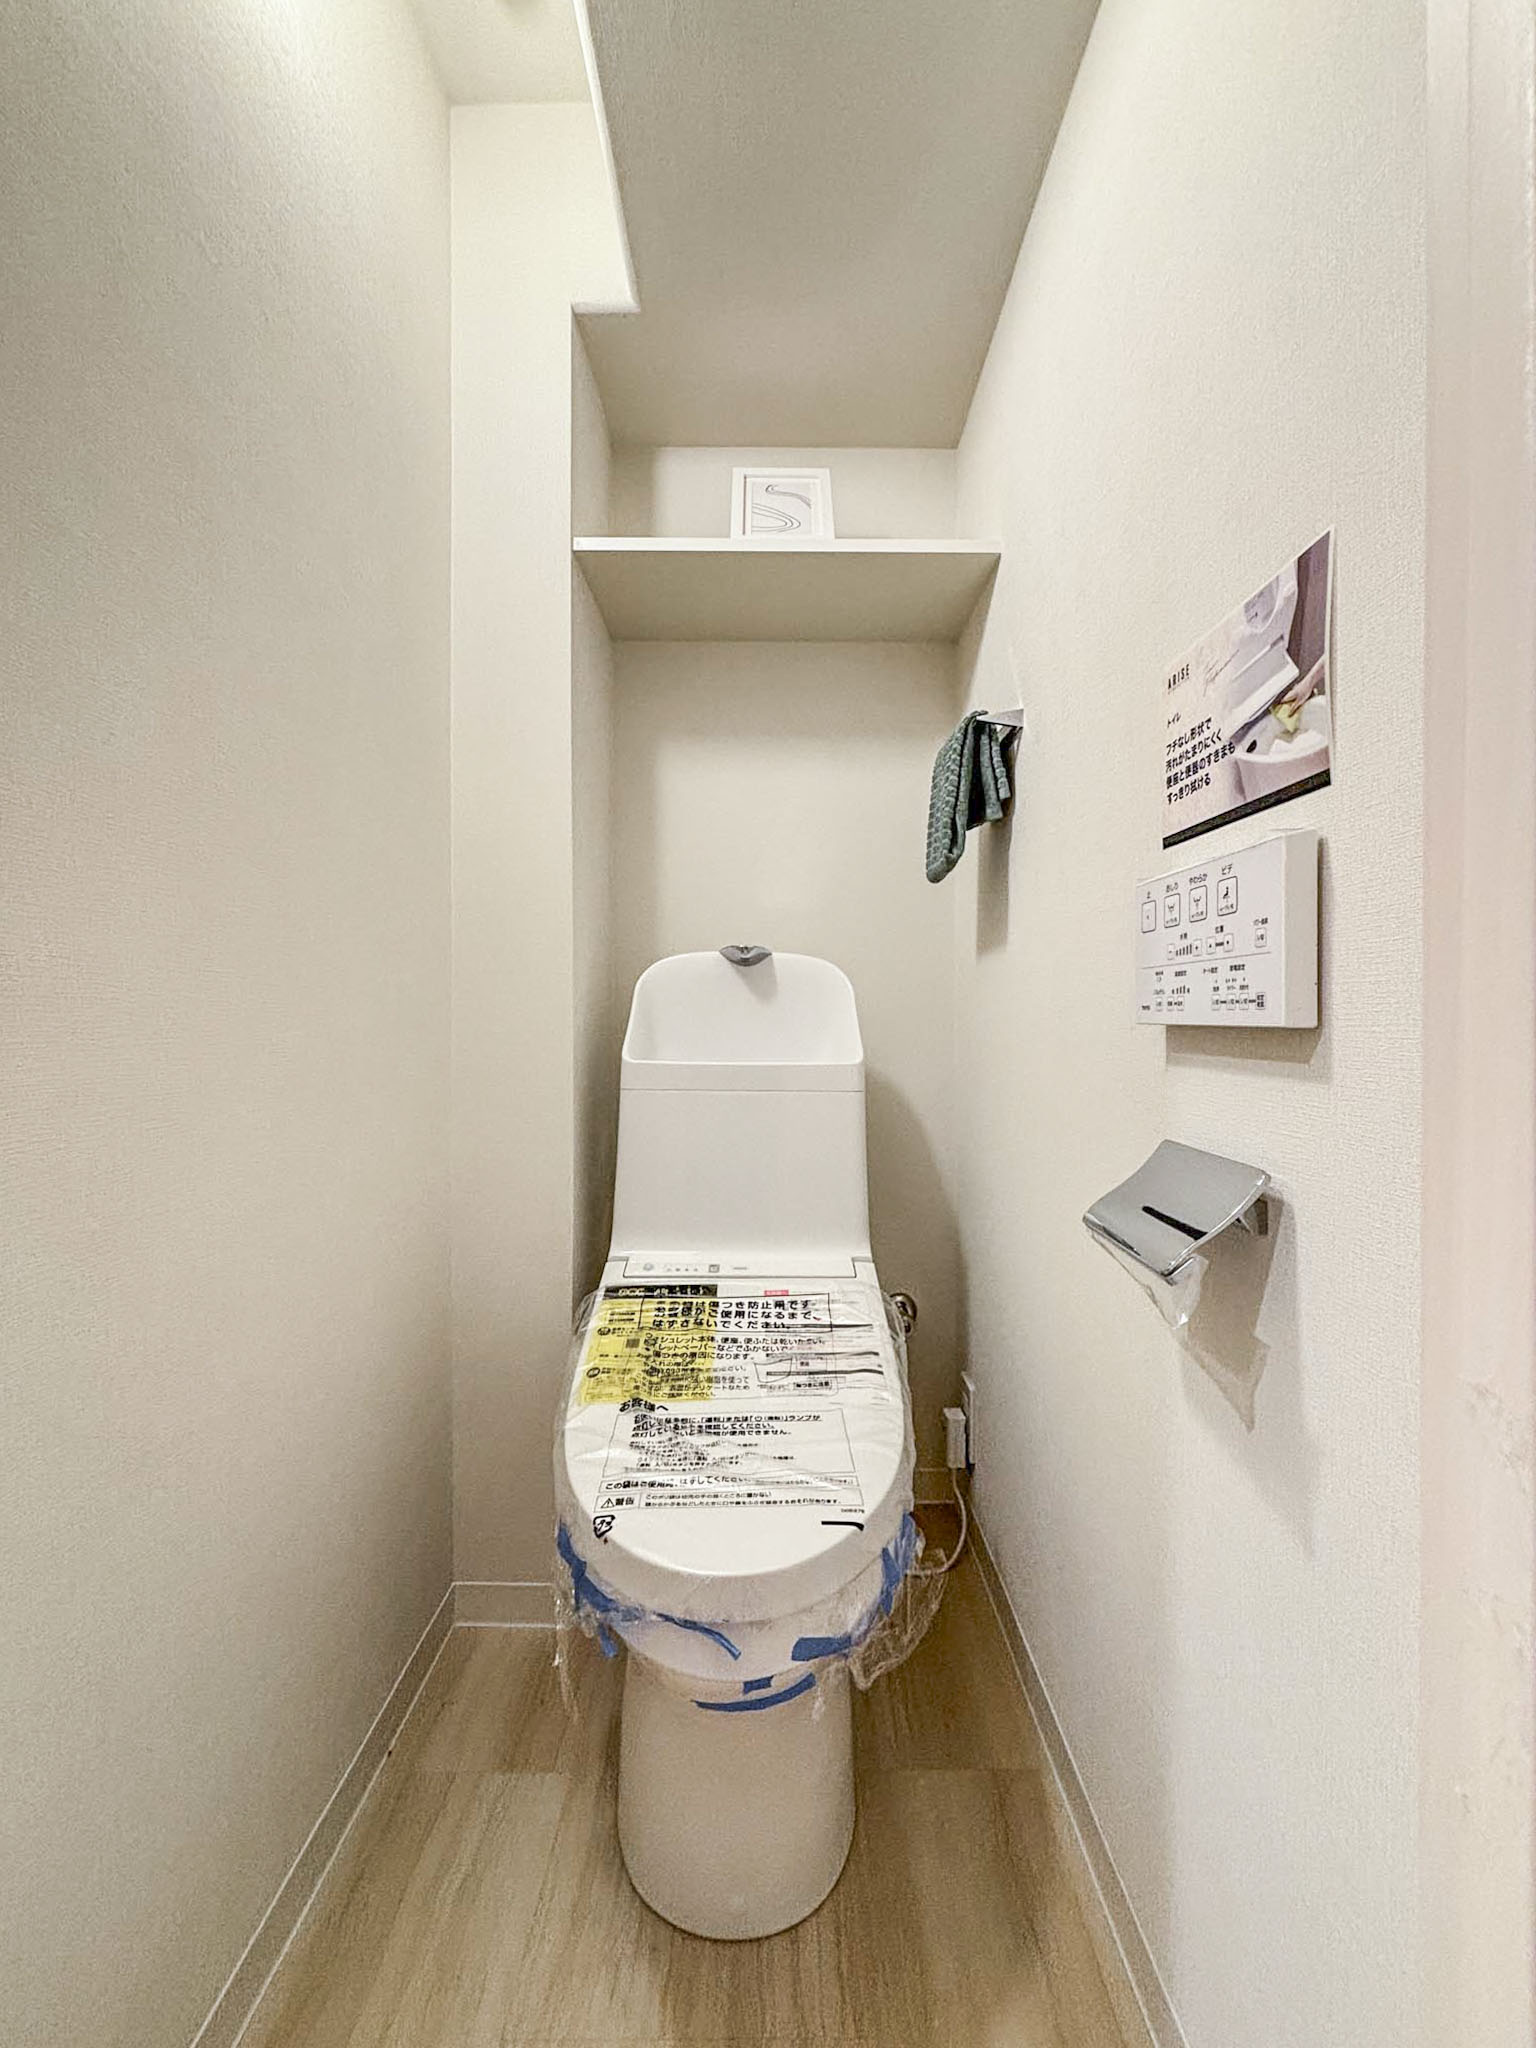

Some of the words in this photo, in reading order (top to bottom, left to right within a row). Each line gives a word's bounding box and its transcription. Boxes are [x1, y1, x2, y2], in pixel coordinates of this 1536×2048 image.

[1168, 664, 1190, 690] ARISE
[1166, 717, 1212, 755] フチなし形状で
[1167, 712, 1181, 728] トイレ
[1165, 728, 1222, 773] 汚れがたまりにくく
[1166, 742, 1236, 790] 便座と便器のすきまも
[1166, 772, 1211, 805] すっきり拭ける
